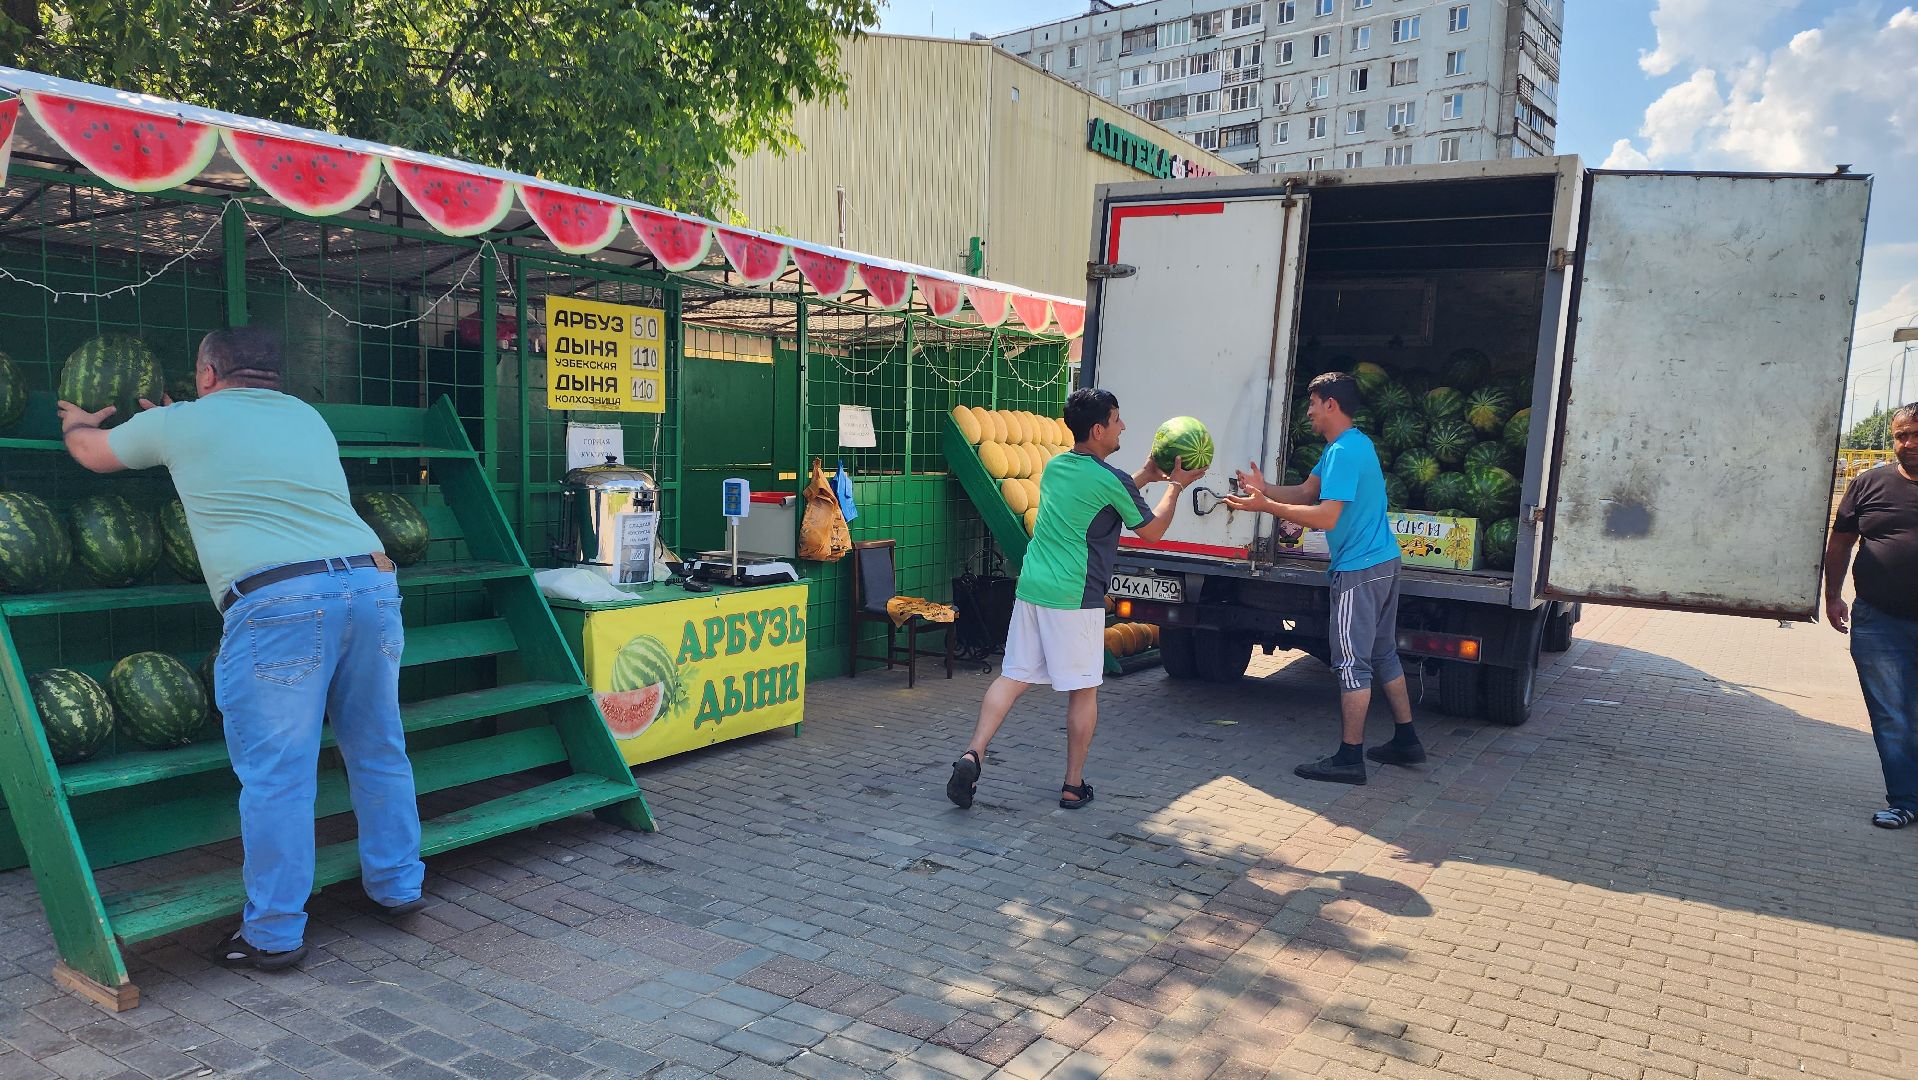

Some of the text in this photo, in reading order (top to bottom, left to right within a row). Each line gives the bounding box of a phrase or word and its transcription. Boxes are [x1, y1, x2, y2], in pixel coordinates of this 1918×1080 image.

[1090, 118, 1171, 179] АПТЕКА
[554, 309, 657, 338] АРБУЗ 50
[554, 336, 657, 368] ДЫНЯ 110
[554, 358, 617, 371] УЗБЕКСКАЯ
[554, 374, 653, 399] ДЫНЯ 110
[555, 395, 621, 405] КОЛХОЗНИЦА
[1153, 580, 1177, 594] 750
[693, 662, 800, 730] ДЫНИ
